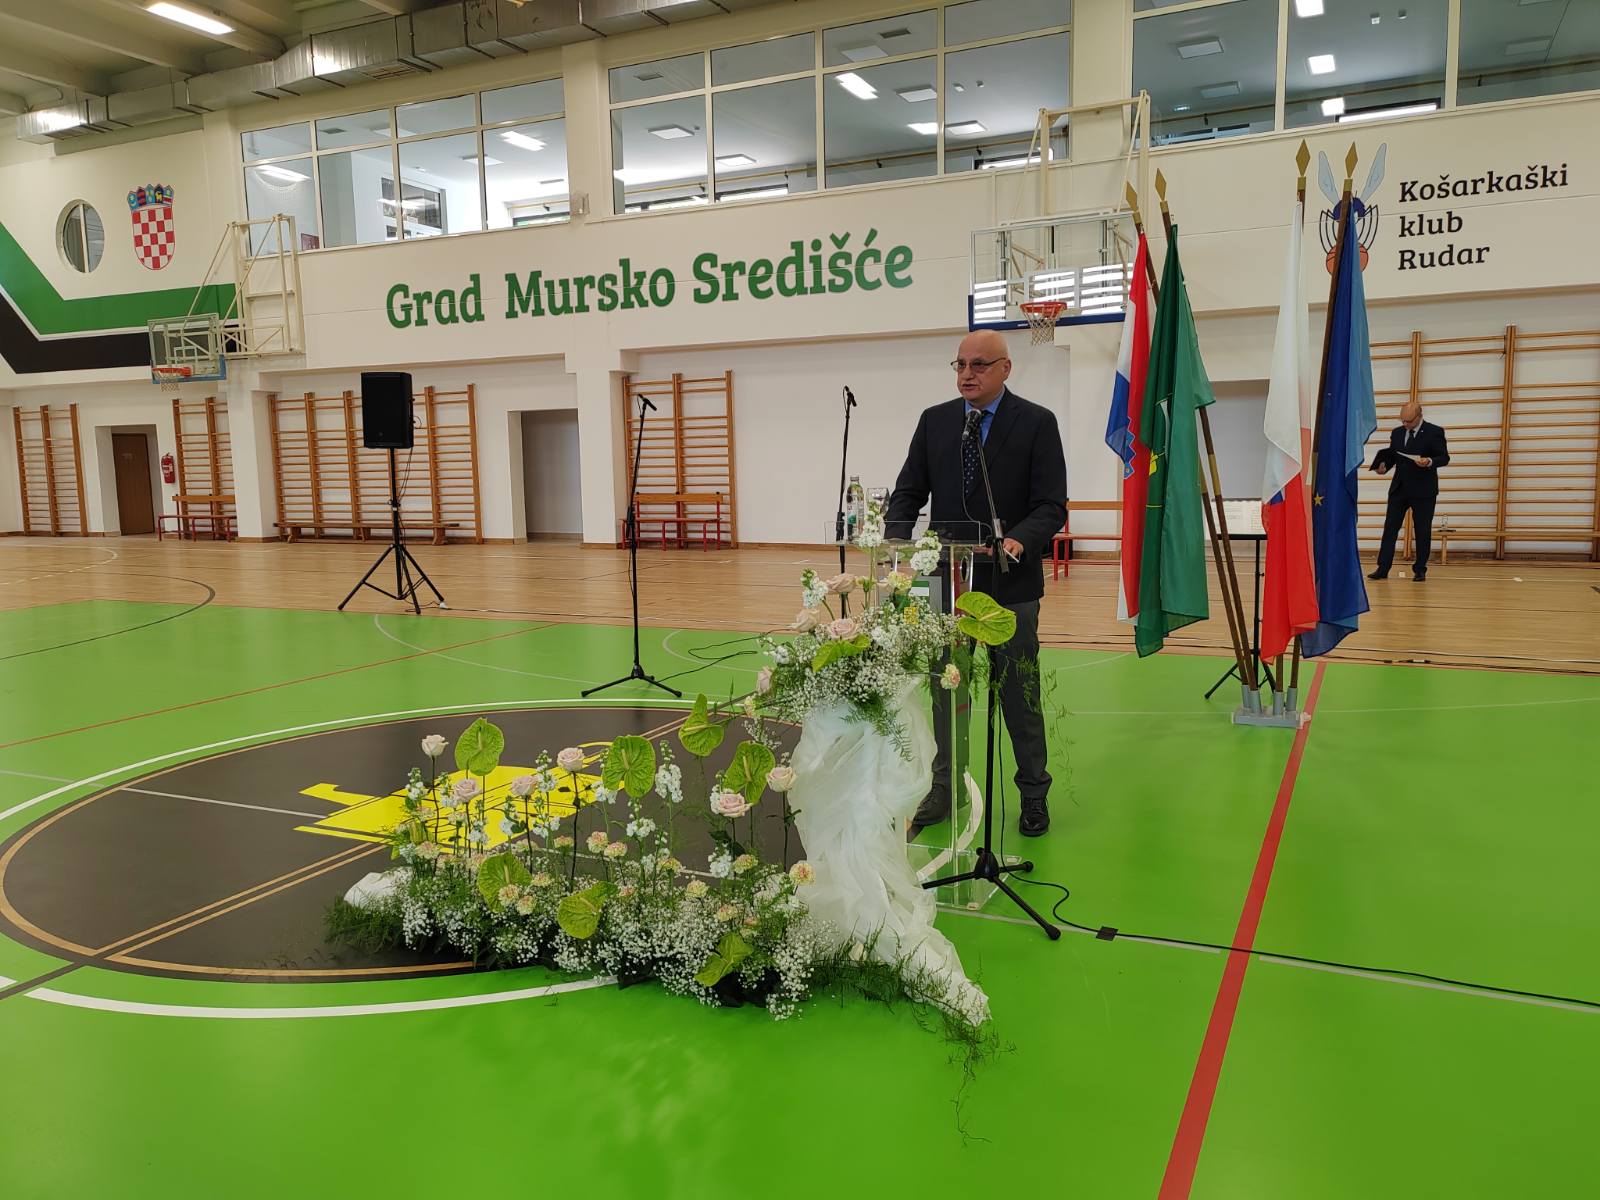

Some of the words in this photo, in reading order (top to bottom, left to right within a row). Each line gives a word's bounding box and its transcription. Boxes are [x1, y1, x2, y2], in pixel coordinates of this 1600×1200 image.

[1398, 162, 1568, 203] Košarkaški
[1398, 210, 1463, 238] klub
[1397, 244, 1490, 271] Rudar
[386, 273, 485, 328] Grad
[506, 259, 675, 319] Mursko
[693, 228, 913, 304] Središće
